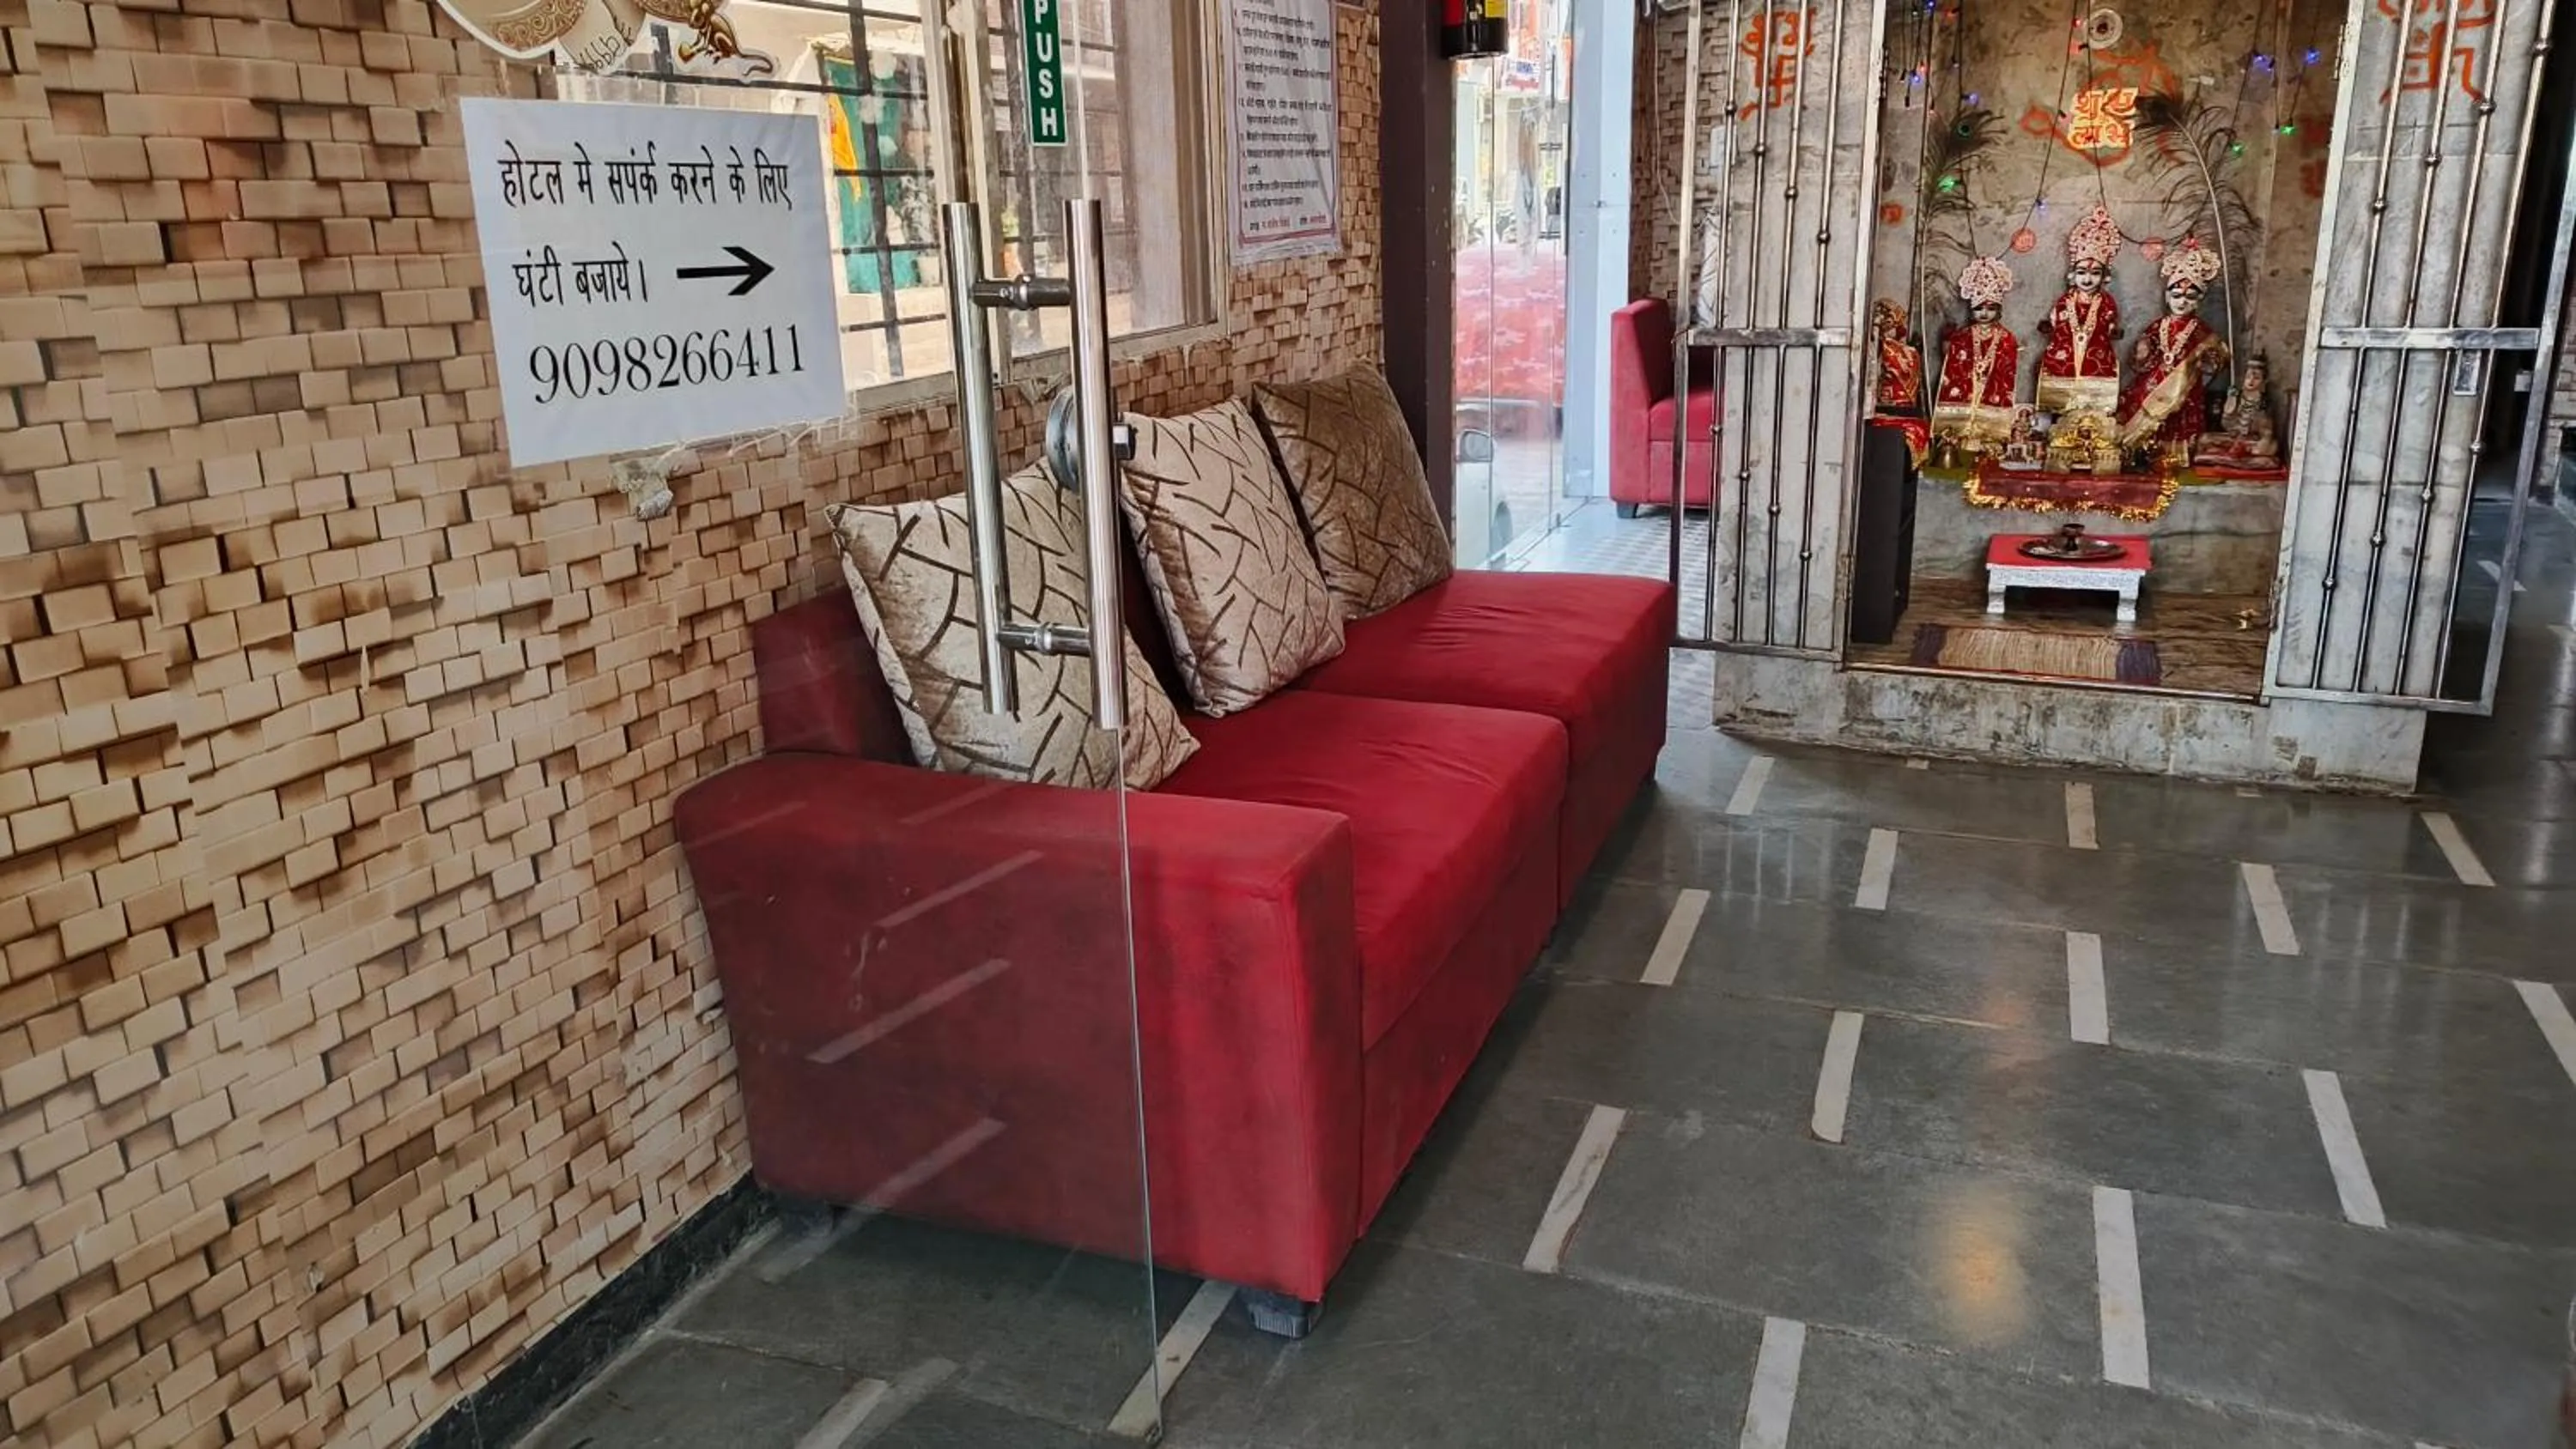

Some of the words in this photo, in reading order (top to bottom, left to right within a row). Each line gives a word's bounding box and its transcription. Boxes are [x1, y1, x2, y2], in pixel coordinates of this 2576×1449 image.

[1034, 0, 1059, 136] PUSH
[497, 139, 564, 207] होटल
[572, 141, 594, 204] मे
[667, 144, 717, 205] करने
[726, 145, 746, 203] के
[753, 147, 793, 211] लिए
[512, 245, 564, 307] घंटी
[530, 324, 804, 404] 9098266411
